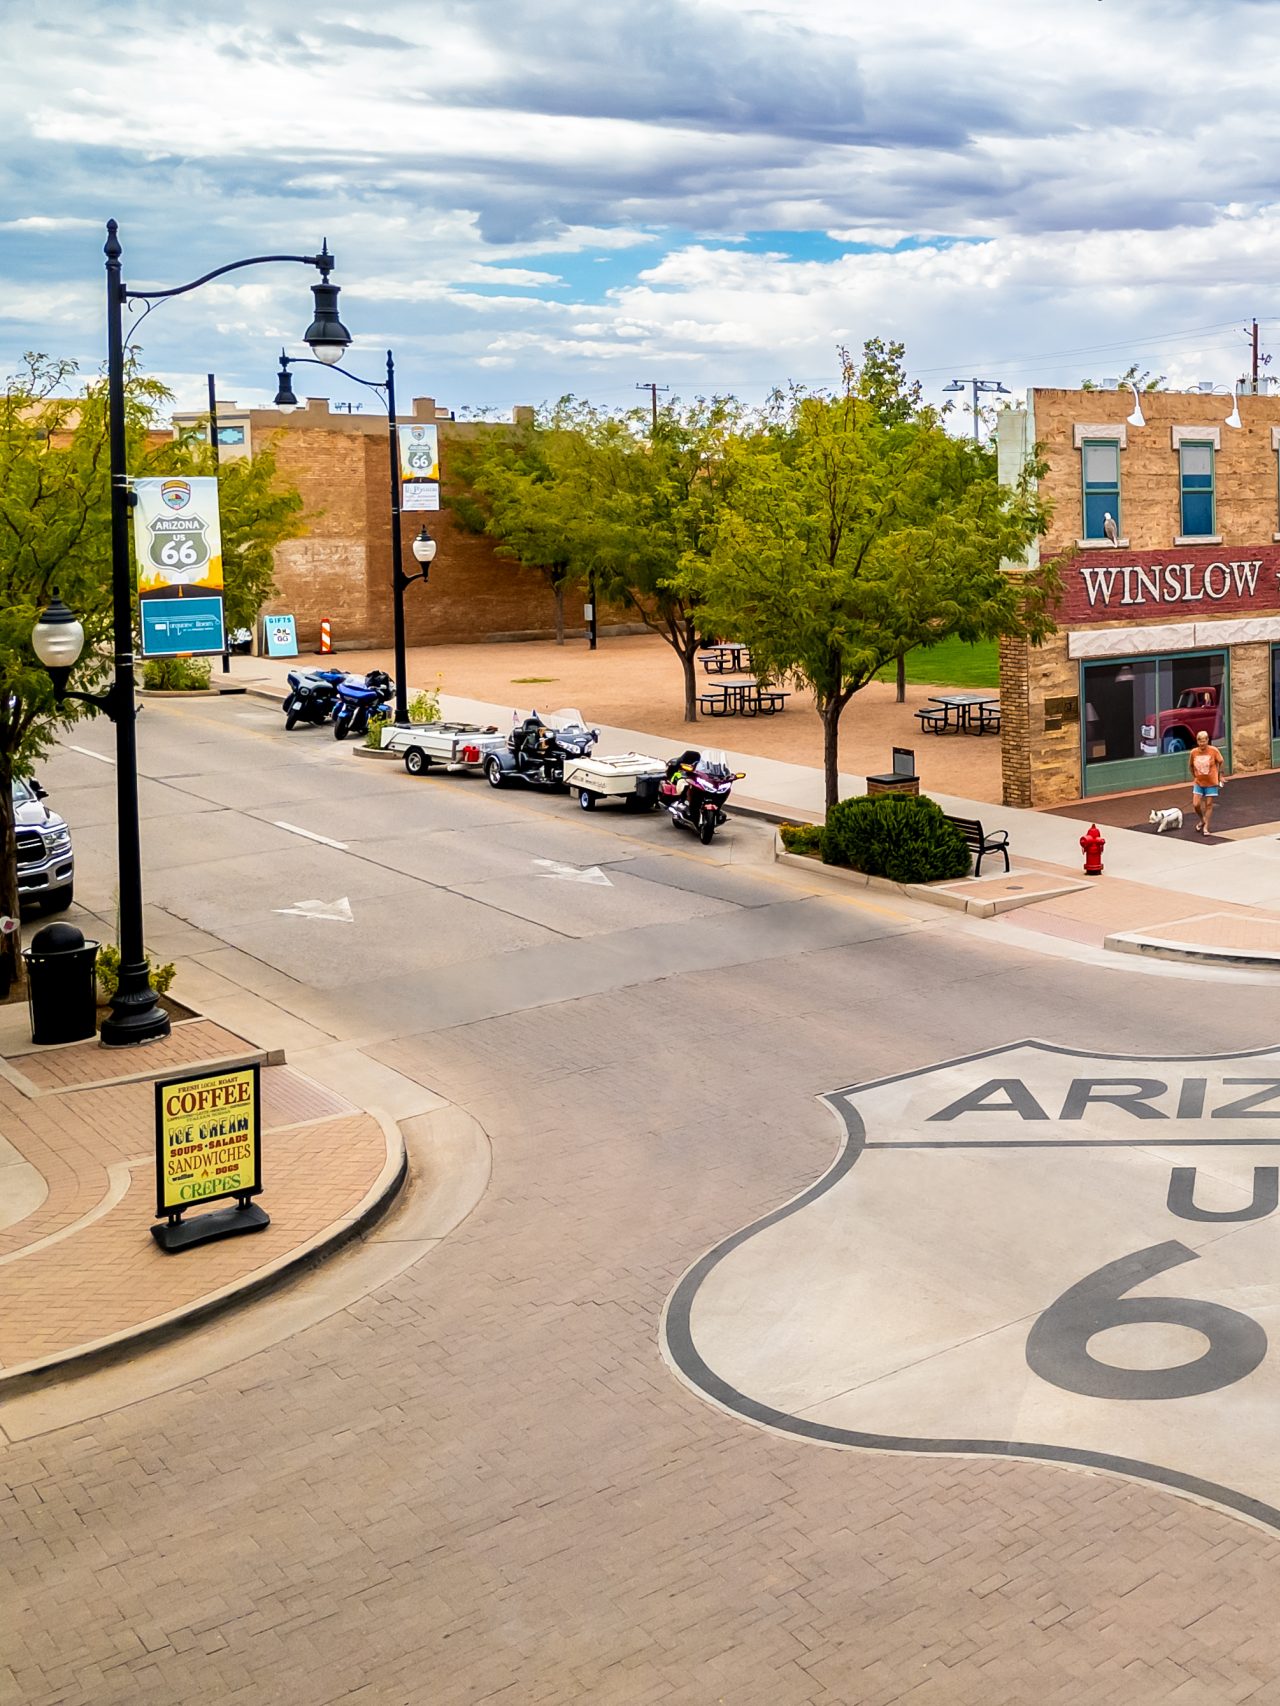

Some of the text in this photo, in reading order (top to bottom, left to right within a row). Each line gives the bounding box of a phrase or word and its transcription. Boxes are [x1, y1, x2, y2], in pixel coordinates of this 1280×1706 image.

[412, 455, 428, 468] 66
[155, 520, 200, 531] ARIZONA
[161, 540, 197, 565] 66
[1080, 561, 1264, 607] WINSLOW
[178, 1077, 238, 1093] FRESH LOCAL ROAST
[166, 1081, 251, 1116] COFFEE
[168, 1112, 250, 1147] ICE CREAM
[170, 1134, 248, 1157] SOUPS SALADS
[168, 1143, 251, 1176] SANDWICHES
[216, 1163, 239, 1175] DOGS
[180, 1173, 241, 1200] CREPES
